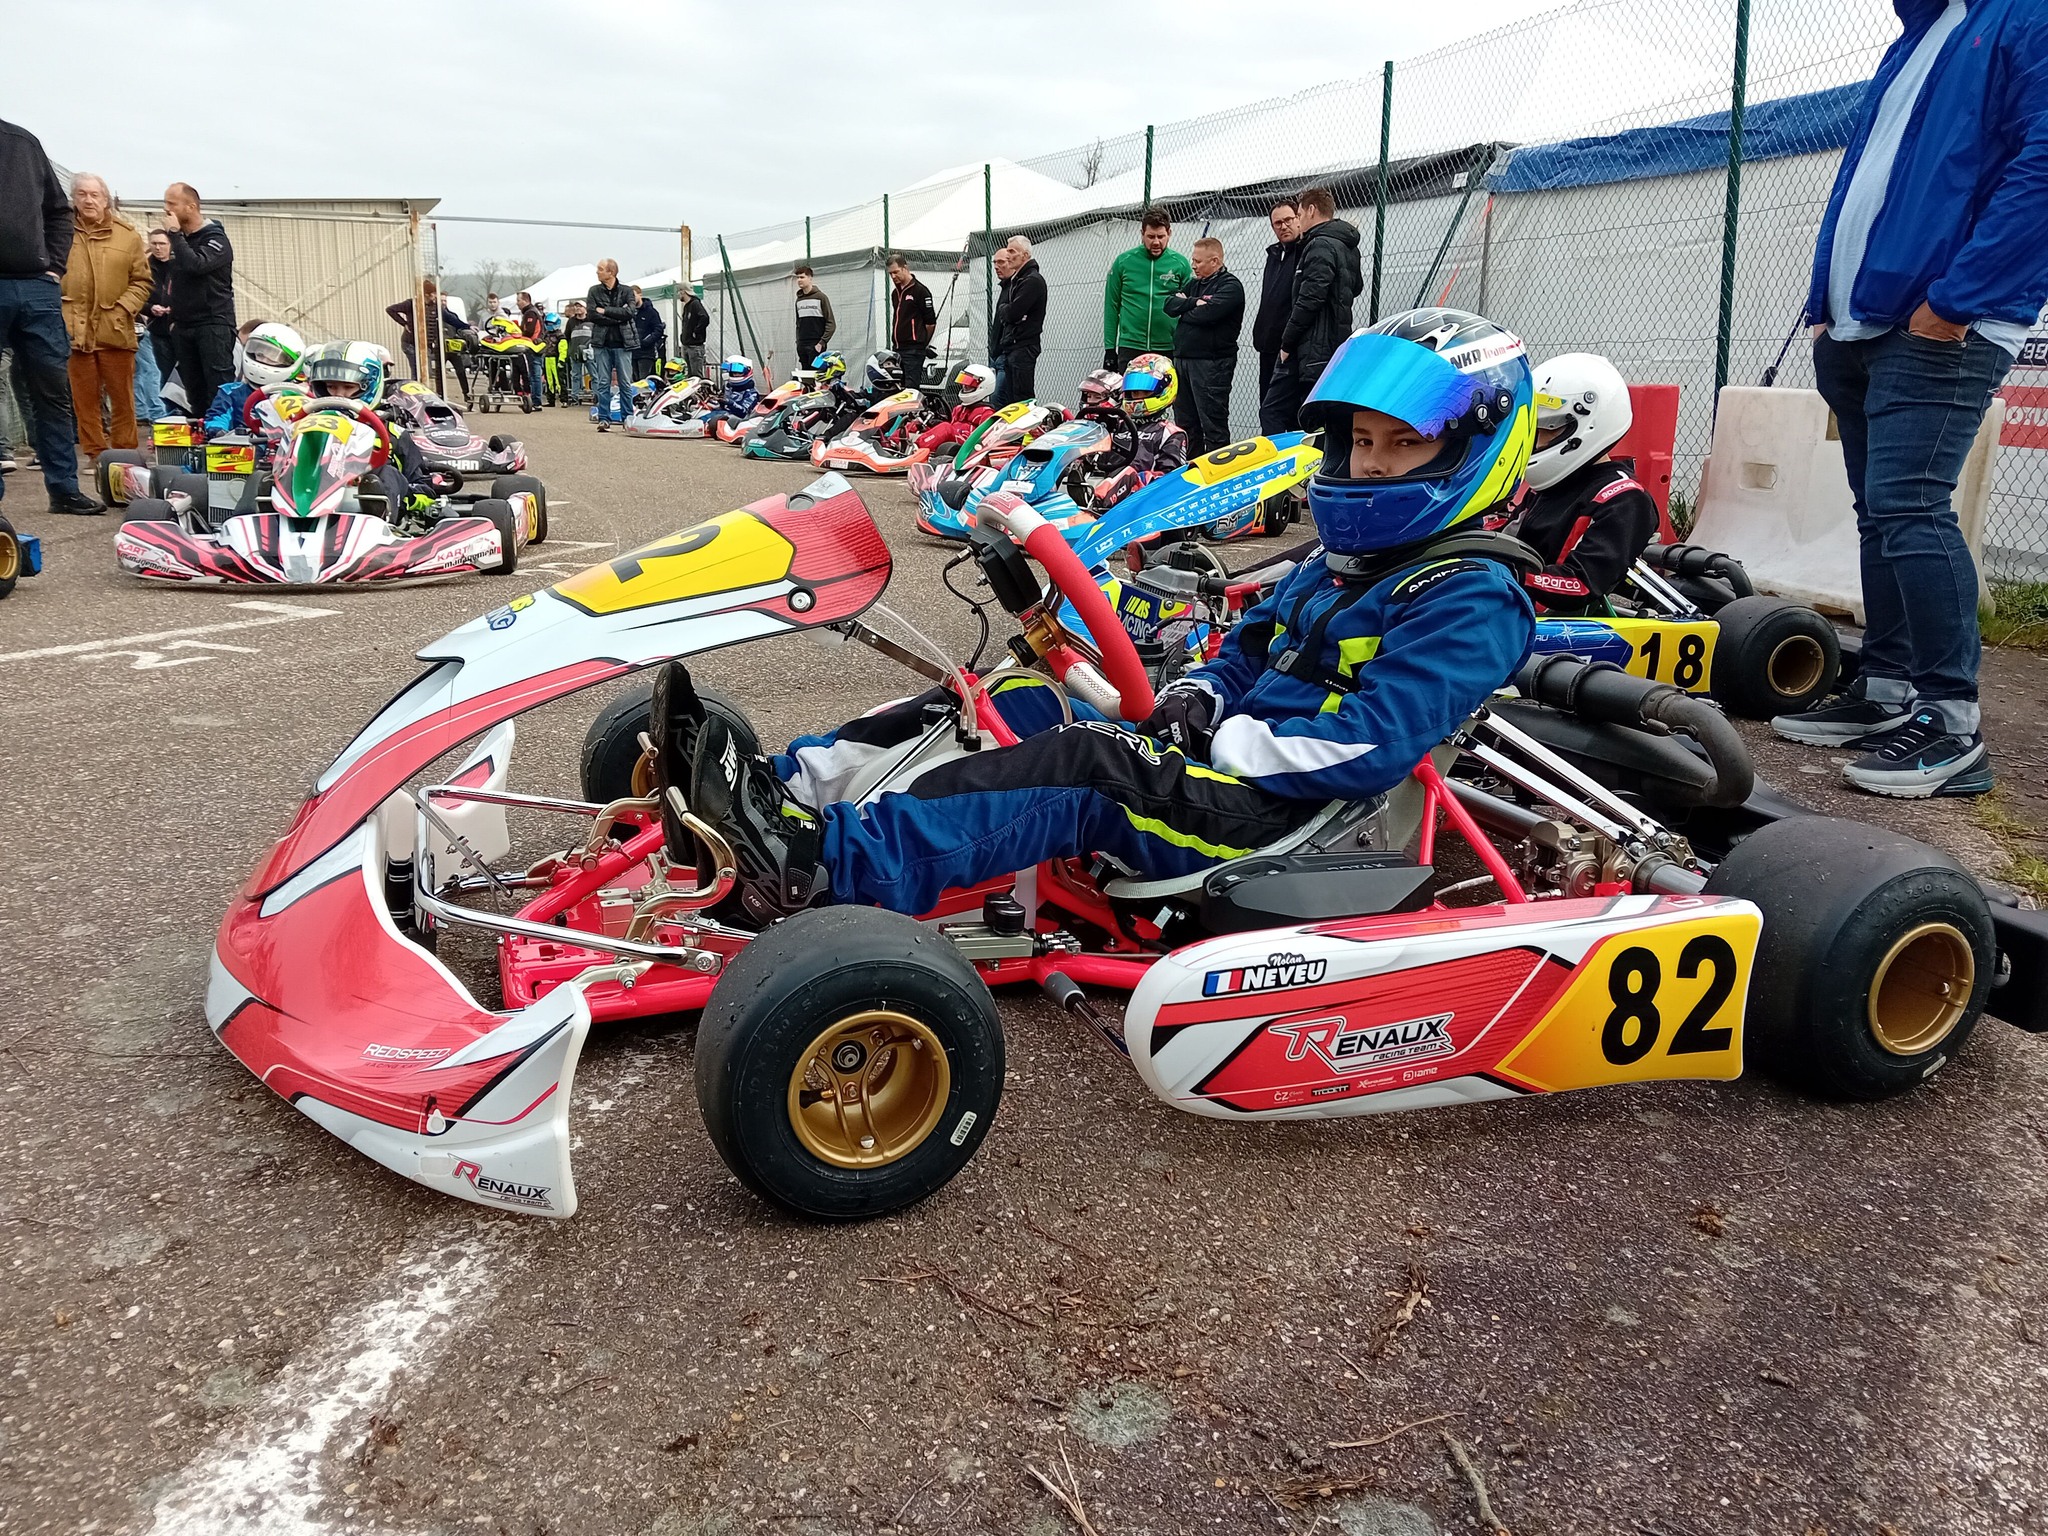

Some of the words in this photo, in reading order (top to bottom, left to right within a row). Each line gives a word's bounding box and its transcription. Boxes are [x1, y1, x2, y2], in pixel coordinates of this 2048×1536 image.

[1450, 348, 1482, 369] NKR
[298, 417, 339, 432] 33
[2005, 405, 2048, 427] OTU
[1208, 442, 1258, 465] 8
[1601, 481, 1637, 499] sparco
[118, 542, 147, 557] KART
[437, 545, 468, 562] KART
[119, 552, 171, 574] management
[1534, 574, 1581, 590] sparco
[1640, 632, 1706, 689] 18
[1269, 954, 1303, 967] Nolan
[1241, 961, 1325, 990] NEVEU
[1601, 934, 1738, 1068] 82
[1280, 1017, 1447, 1062] RENAUX
[454, 1160, 546, 1199] RENAUX
